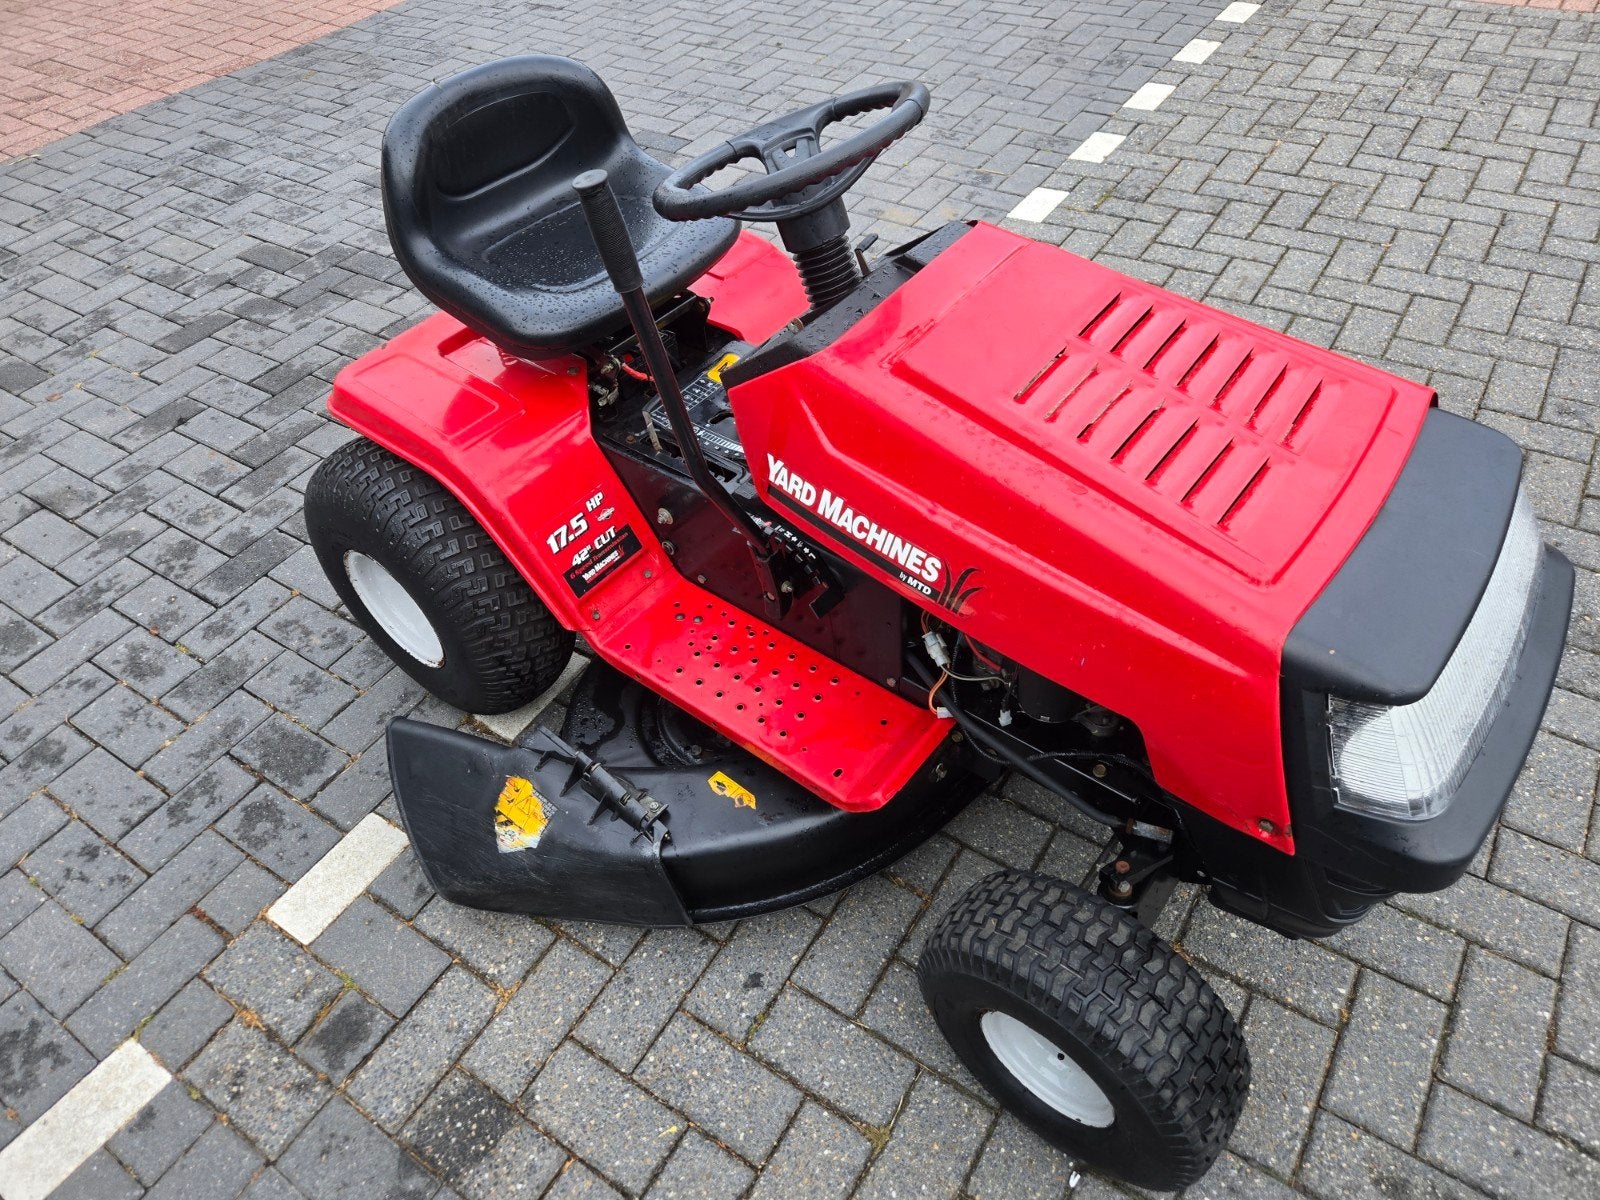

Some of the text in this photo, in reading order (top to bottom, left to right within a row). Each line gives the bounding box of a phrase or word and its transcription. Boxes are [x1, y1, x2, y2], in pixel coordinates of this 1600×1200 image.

[585, 491, 604, 512] HP
[767, 453, 942, 583] YARD MACHINES
[546, 512, 590, 554] 17.5
[572, 526, 616, 566] 42" CUT
[899, 571, 932, 596] by MTD
